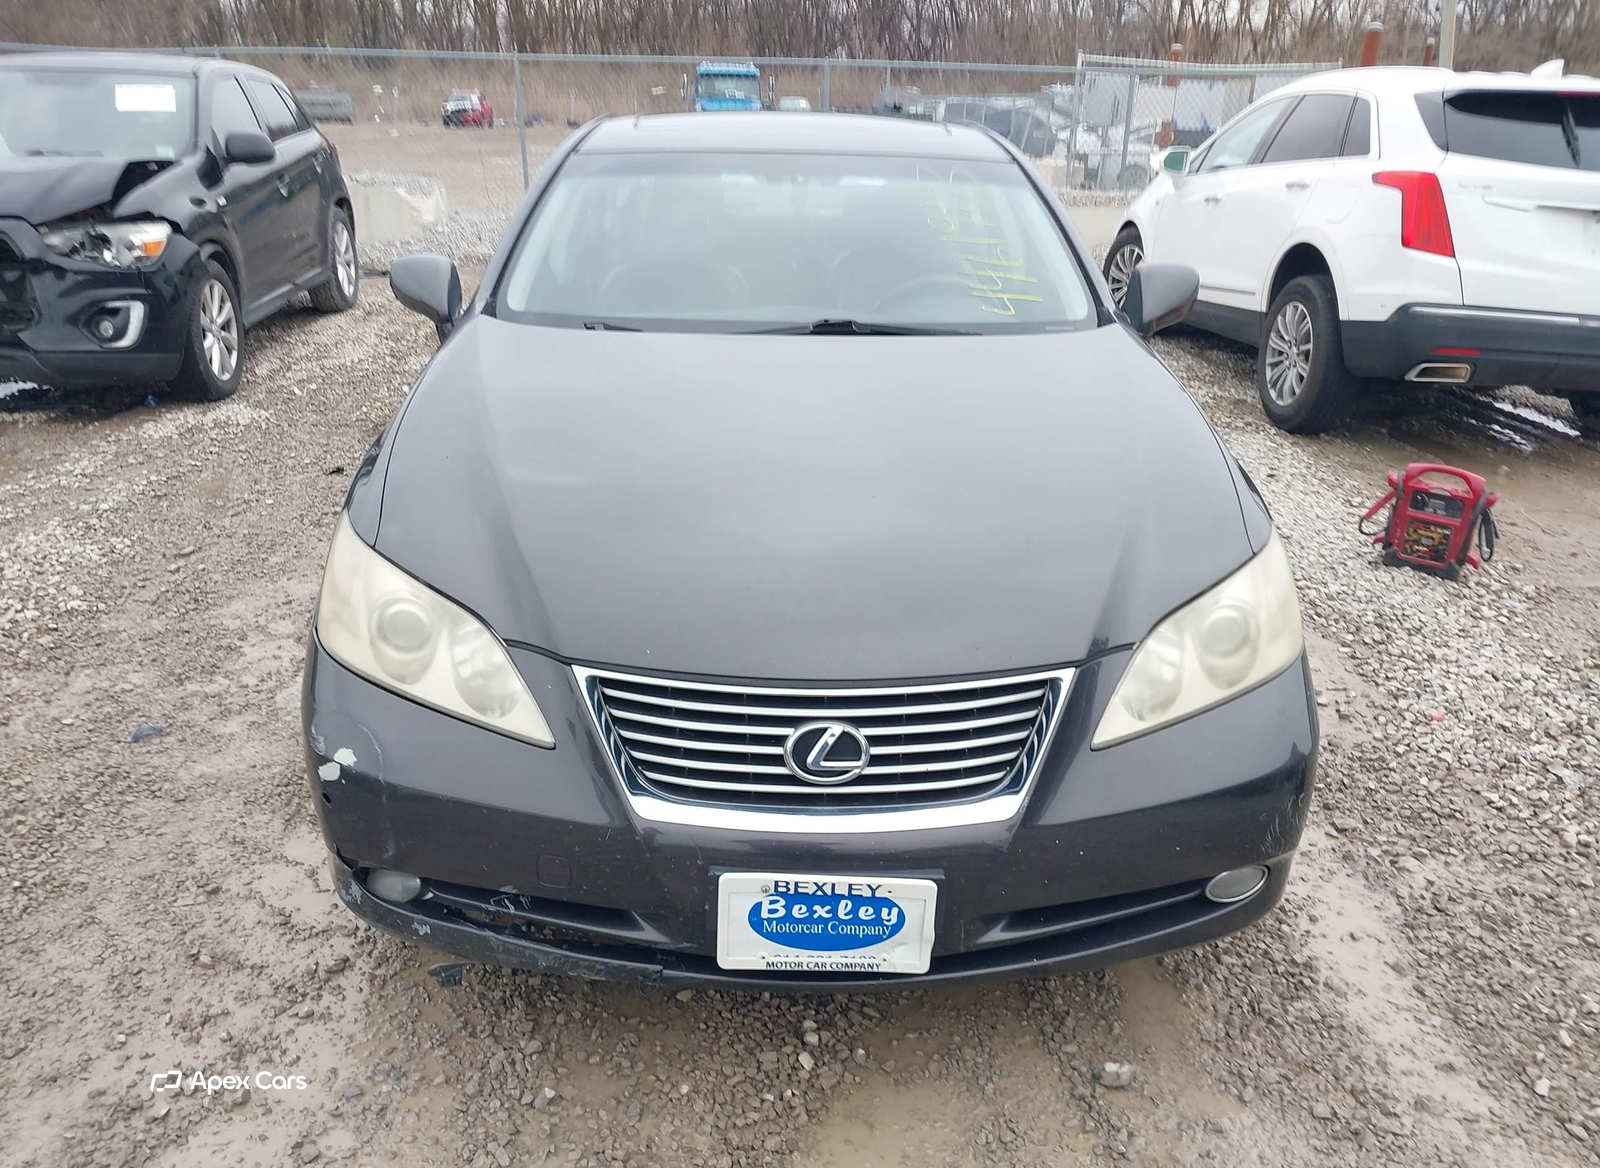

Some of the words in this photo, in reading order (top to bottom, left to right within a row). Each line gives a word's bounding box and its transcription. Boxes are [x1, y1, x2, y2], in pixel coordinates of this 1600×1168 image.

[774, 880, 883, 897] BEXLEY
[760, 896, 899, 925] Bexley
[763, 920, 824, 934] Motorcar
[828, 921, 891, 938] Company
[765, 961, 804, 970] MOTOR
[806, 961, 827, 970] CAR
[829, 962, 881, 971] COMPANY
